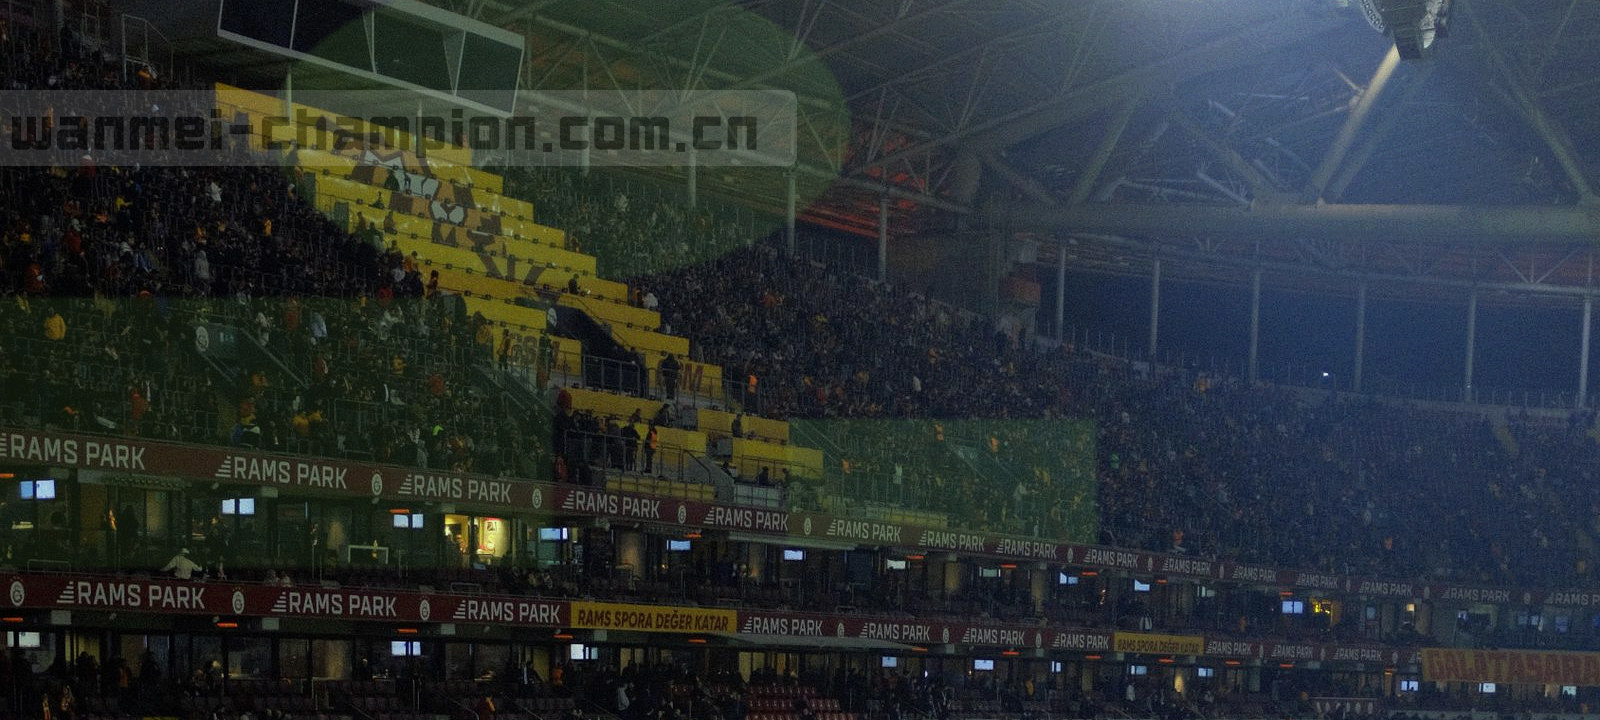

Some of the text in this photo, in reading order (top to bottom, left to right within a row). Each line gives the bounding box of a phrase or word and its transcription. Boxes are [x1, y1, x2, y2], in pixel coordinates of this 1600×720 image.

[11, 434, 145, 470] RAMS PARK
[234, 456, 347, 489] RAMS PARK
[414, 475, 511, 503] RAMS PARK
[575, 491, 660, 519] RAMS PARK
[715, 507, 789, 531] RAMS PARK
[837, 520, 901, 542] RAMS PARK
[928, 531, 985, 551] RAMS PARK
[1005, 539, 1057, 559] RAMS PARK
[1091, 549, 1138, 568] RAMS PARK
[1169, 558, 1211, 575] RAMS PARK
[1238, 567, 1277, 582] RAMS PARK
[1300, 573, 1338, 588] RAMS PARK
[78, 581, 205, 609] RAMS PARK
[1365, 581, 1413, 596] RAMS PARK
[1451, 588, 1510, 602] RAMS PARK
[288, 592, 397, 617] RAMS PARK
[1555, 592, 1588, 605] RAMS
[468, 600, 560, 623] RAMS PARK
[577, 609, 728, 631] RAMS SPORA DEĞER KATAR
[752, 617, 823, 636] RAMS PARK
[869, 623, 930, 641] RAMS PARK
[970, 628, 1025, 645] RAMS PARK
[1061, 633, 1109, 649] RAMS PARK
[1118, 639, 1136, 651] RAMS
[1211, 641, 1251, 655] RAMS PARK
[1276, 644, 1313, 658] RAMS PARK
[1340, 648, 1382, 660] RAMS PARK
